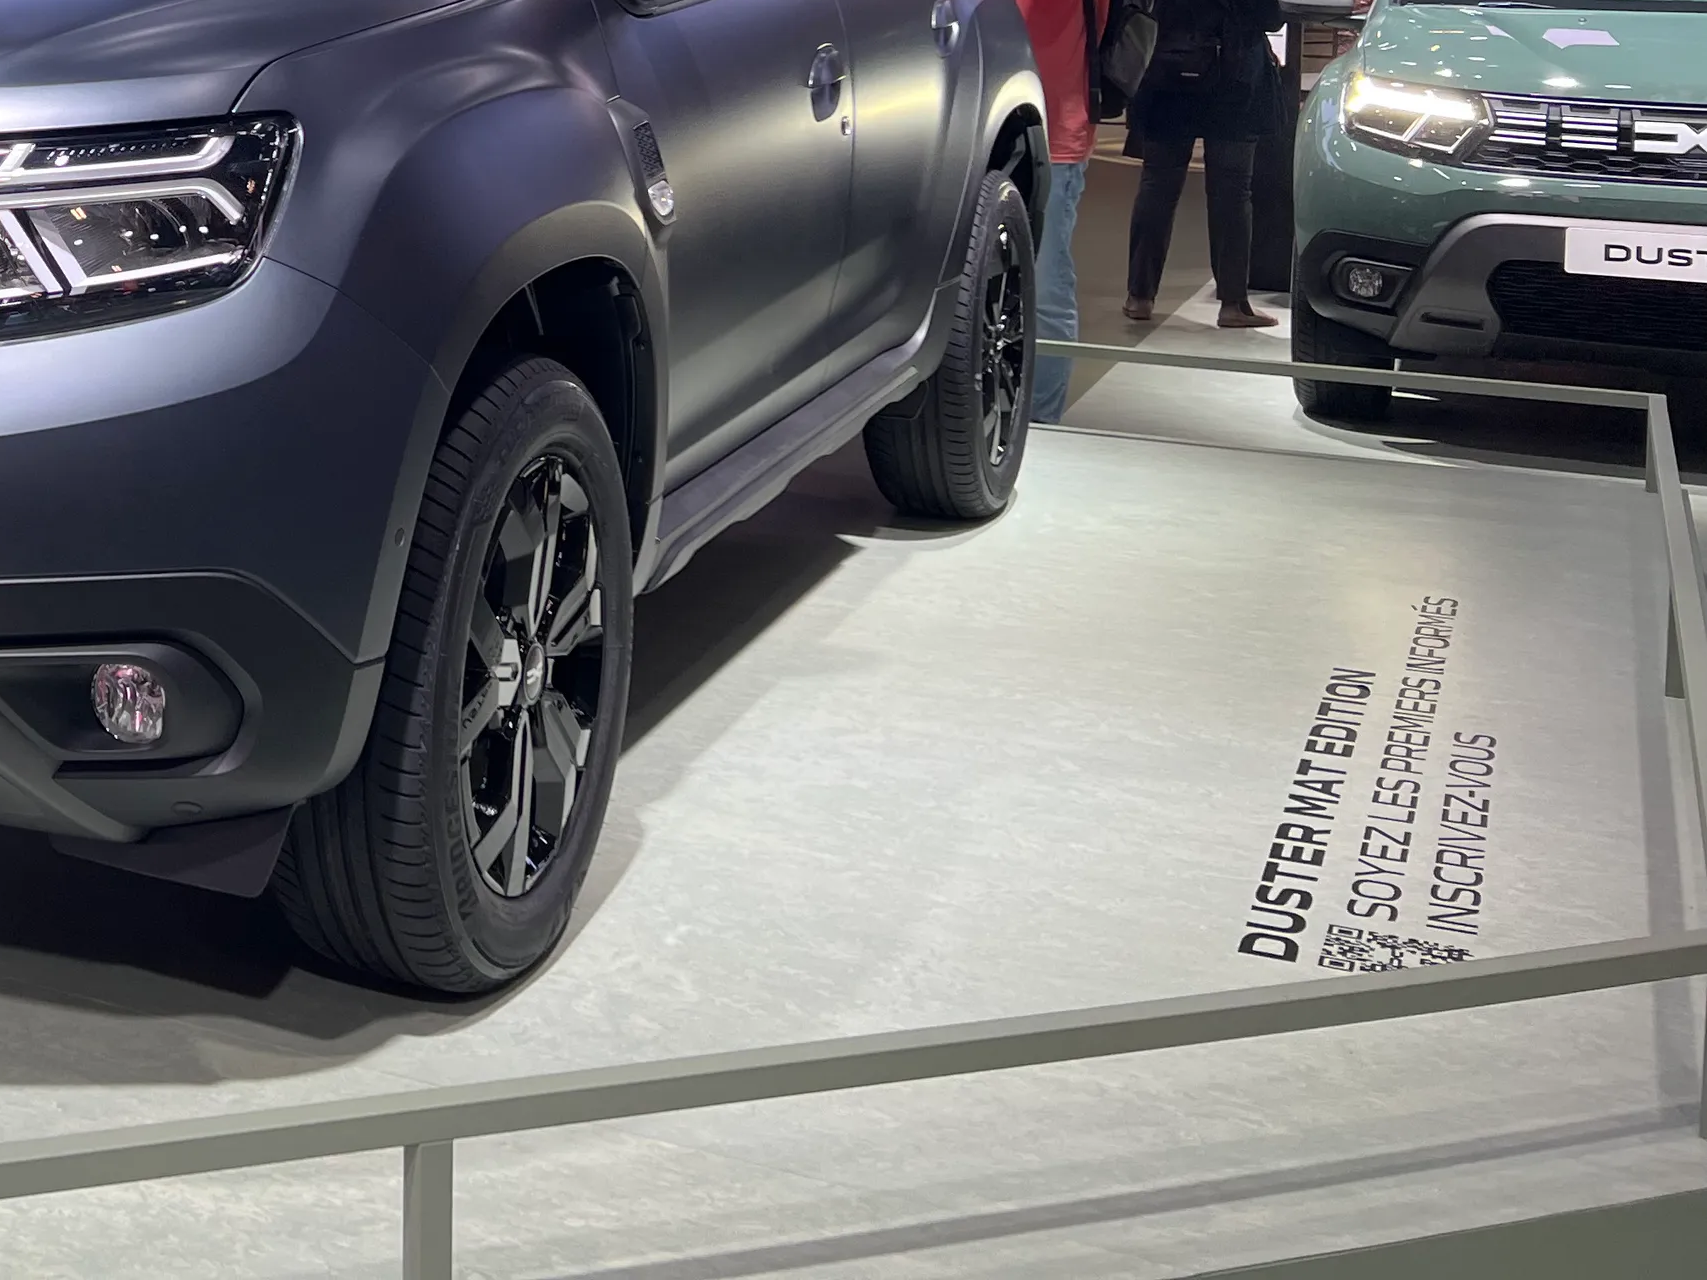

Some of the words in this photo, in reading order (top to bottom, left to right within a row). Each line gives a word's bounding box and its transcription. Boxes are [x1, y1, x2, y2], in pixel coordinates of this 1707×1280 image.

[1405, 595, 1459, 675] INFORMÉS
[1304, 667, 1377, 758] EDITION
[1380, 676, 1442, 775] PREMIERS
[1283, 759, 1348, 820] MAT
[1367, 776, 1421, 825] LES
[1425, 731, 1497, 936] INSCRIVEZ-VOUS
[1237, 822, 1331, 964] DUSTER
[1347, 825, 1412, 923] SOYEZ
